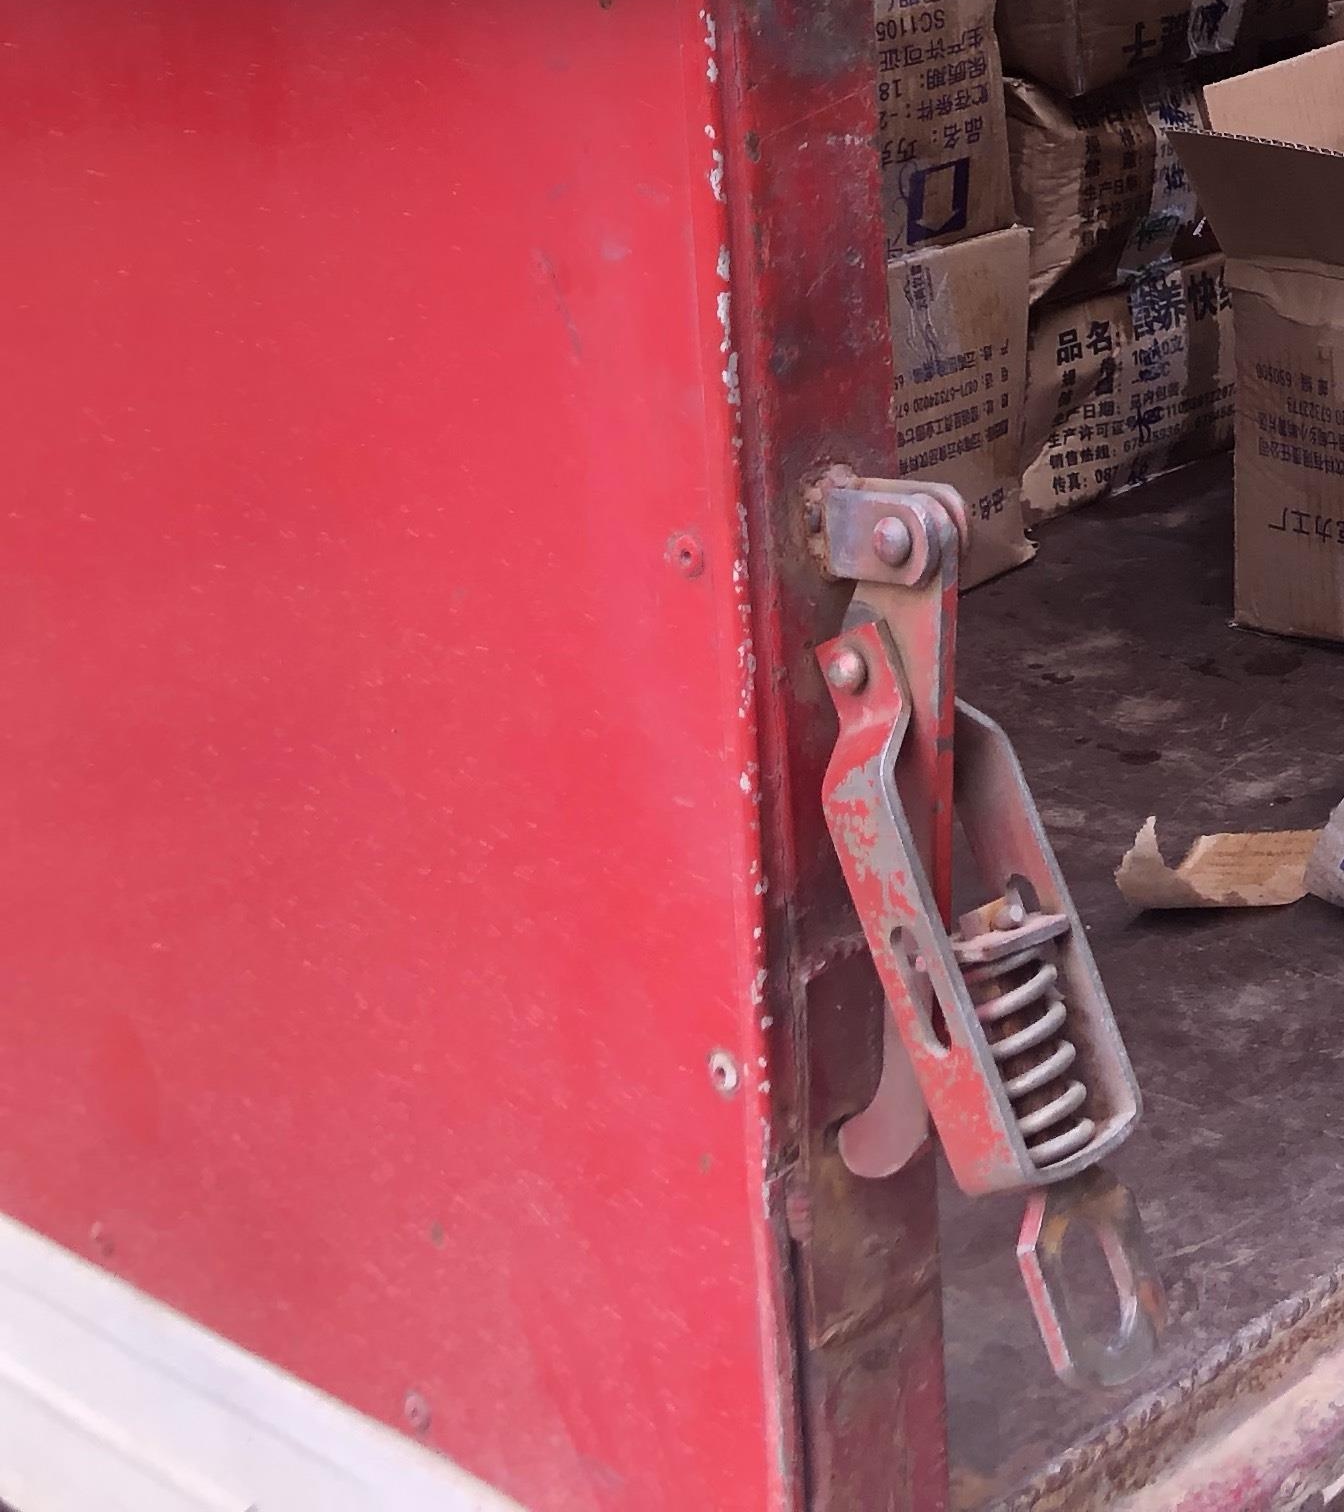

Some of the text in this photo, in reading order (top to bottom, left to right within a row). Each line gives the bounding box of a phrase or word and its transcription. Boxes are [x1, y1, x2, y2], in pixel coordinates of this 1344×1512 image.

[876, 8, 945, 41] SC1105
[879, 27, 984, 72] 生产许可证
[880, 55, 986, 101] 保质期： 18
[933, 116, 983, 149] 品名：
[1057, 321, 1120, 366] 品名：
